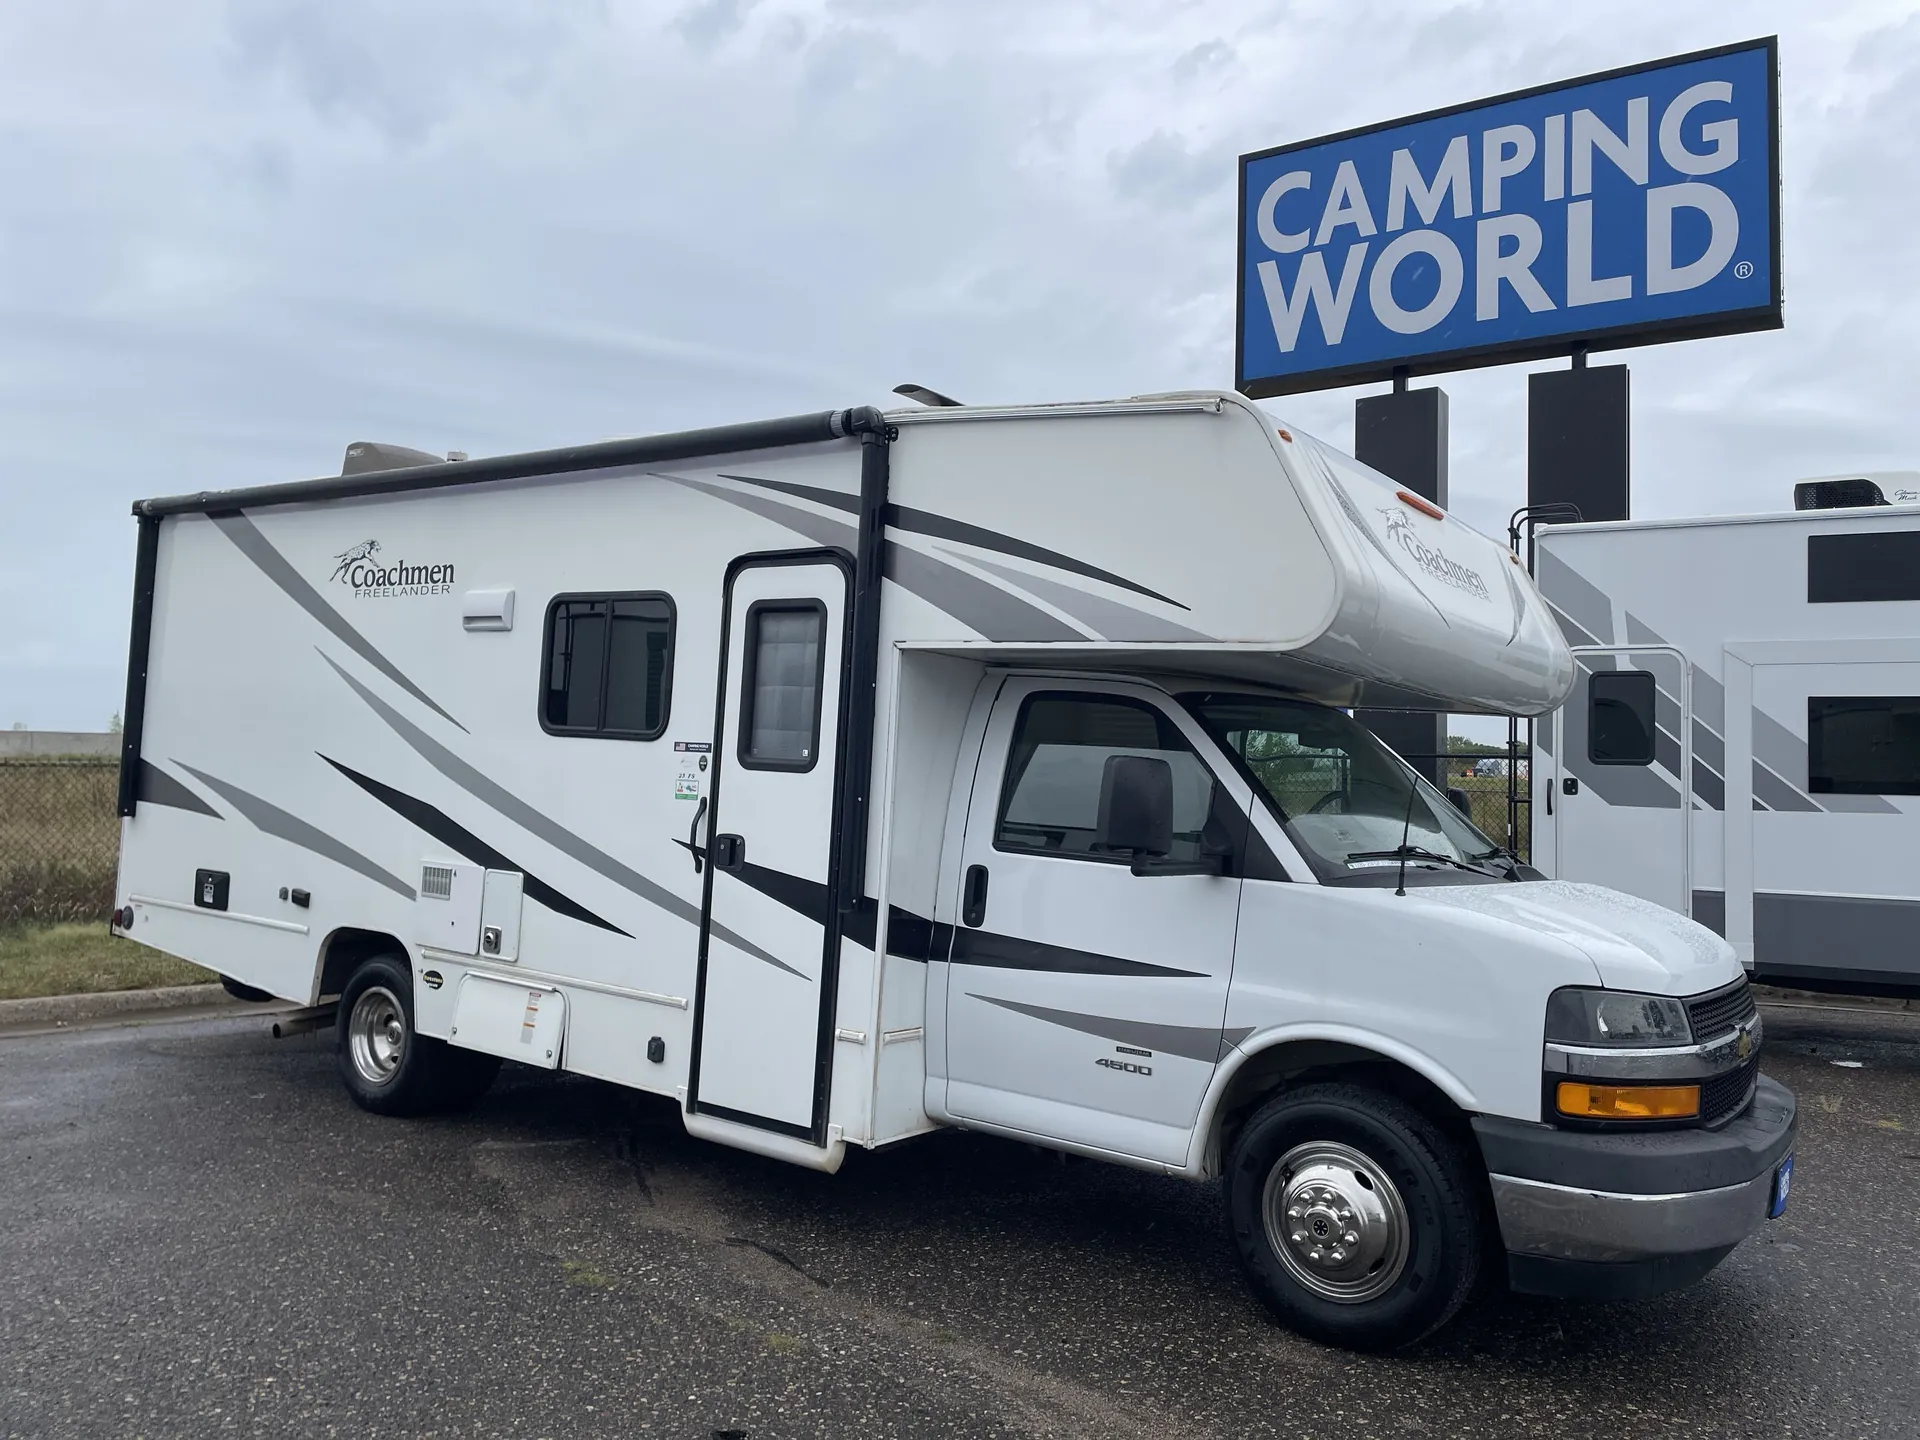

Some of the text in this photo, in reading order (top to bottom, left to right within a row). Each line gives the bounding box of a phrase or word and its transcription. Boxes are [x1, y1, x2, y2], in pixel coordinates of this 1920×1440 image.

[1256, 80, 1739, 254] CAMPING
[1256, 182, 1740, 353] WORLD
[351, 559, 455, 588] Coachmen
[1402, 533, 1489, 594] Coachmen
[354, 584, 451, 599] FREELANDER
[1095, 1058, 1152, 1076] 4500
